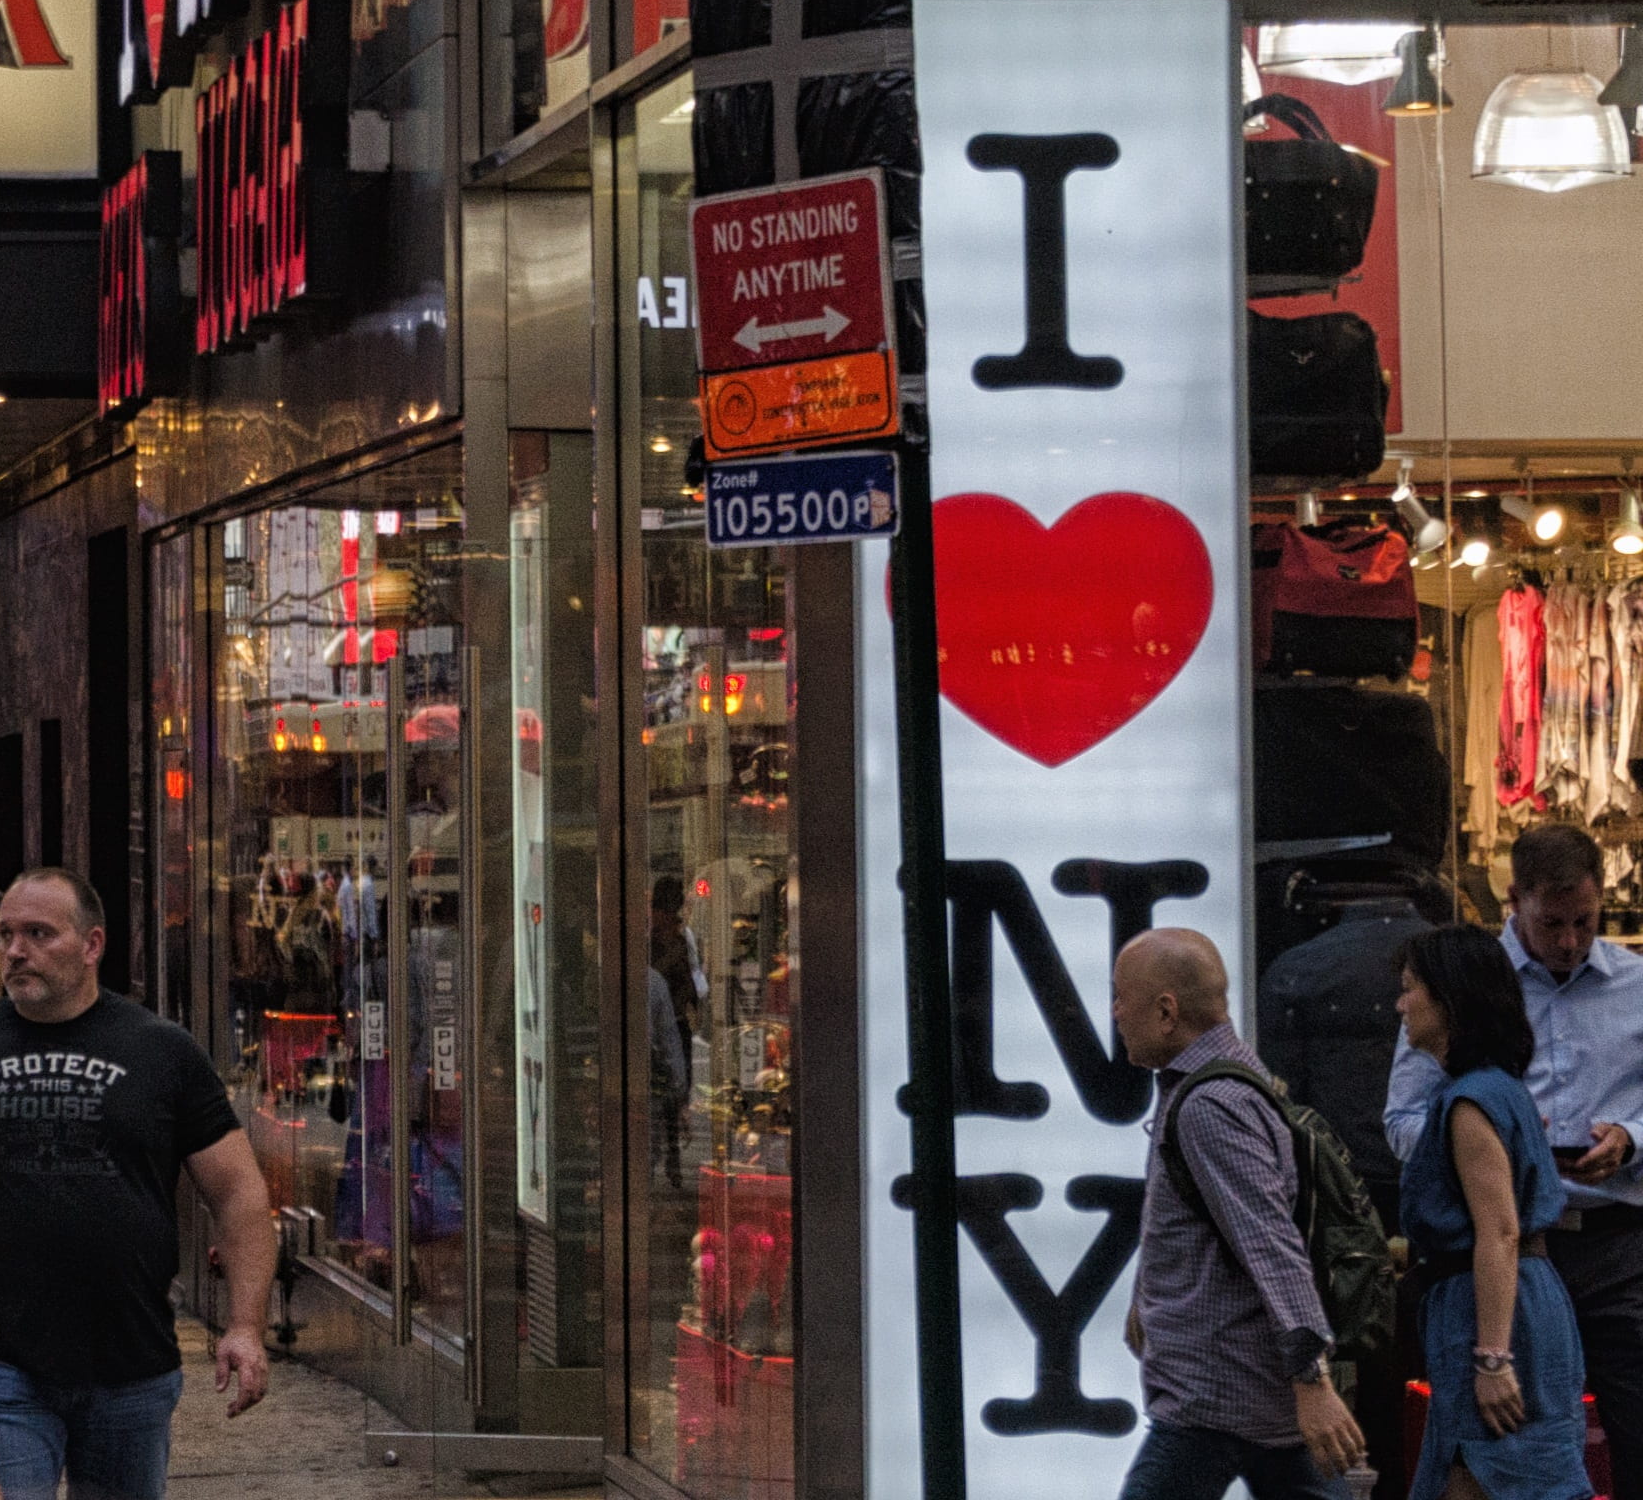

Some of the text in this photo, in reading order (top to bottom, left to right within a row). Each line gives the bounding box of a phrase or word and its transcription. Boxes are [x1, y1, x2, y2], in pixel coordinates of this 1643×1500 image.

[713, 202, 858, 254] NO STANDING
[733, 255, 846, 302] ANYTIME
[965, 132, 1124, 391] I
[712, 471, 759, 490] Zone#
[714, 490, 850, 537] 105500
[368, 1005, 381, 1058] PUSH
[438, 1030, 452, 1087] PULL
[0, 1095, 103, 1121] HOUSE
[29, 1079, 73, 1093] THIS
